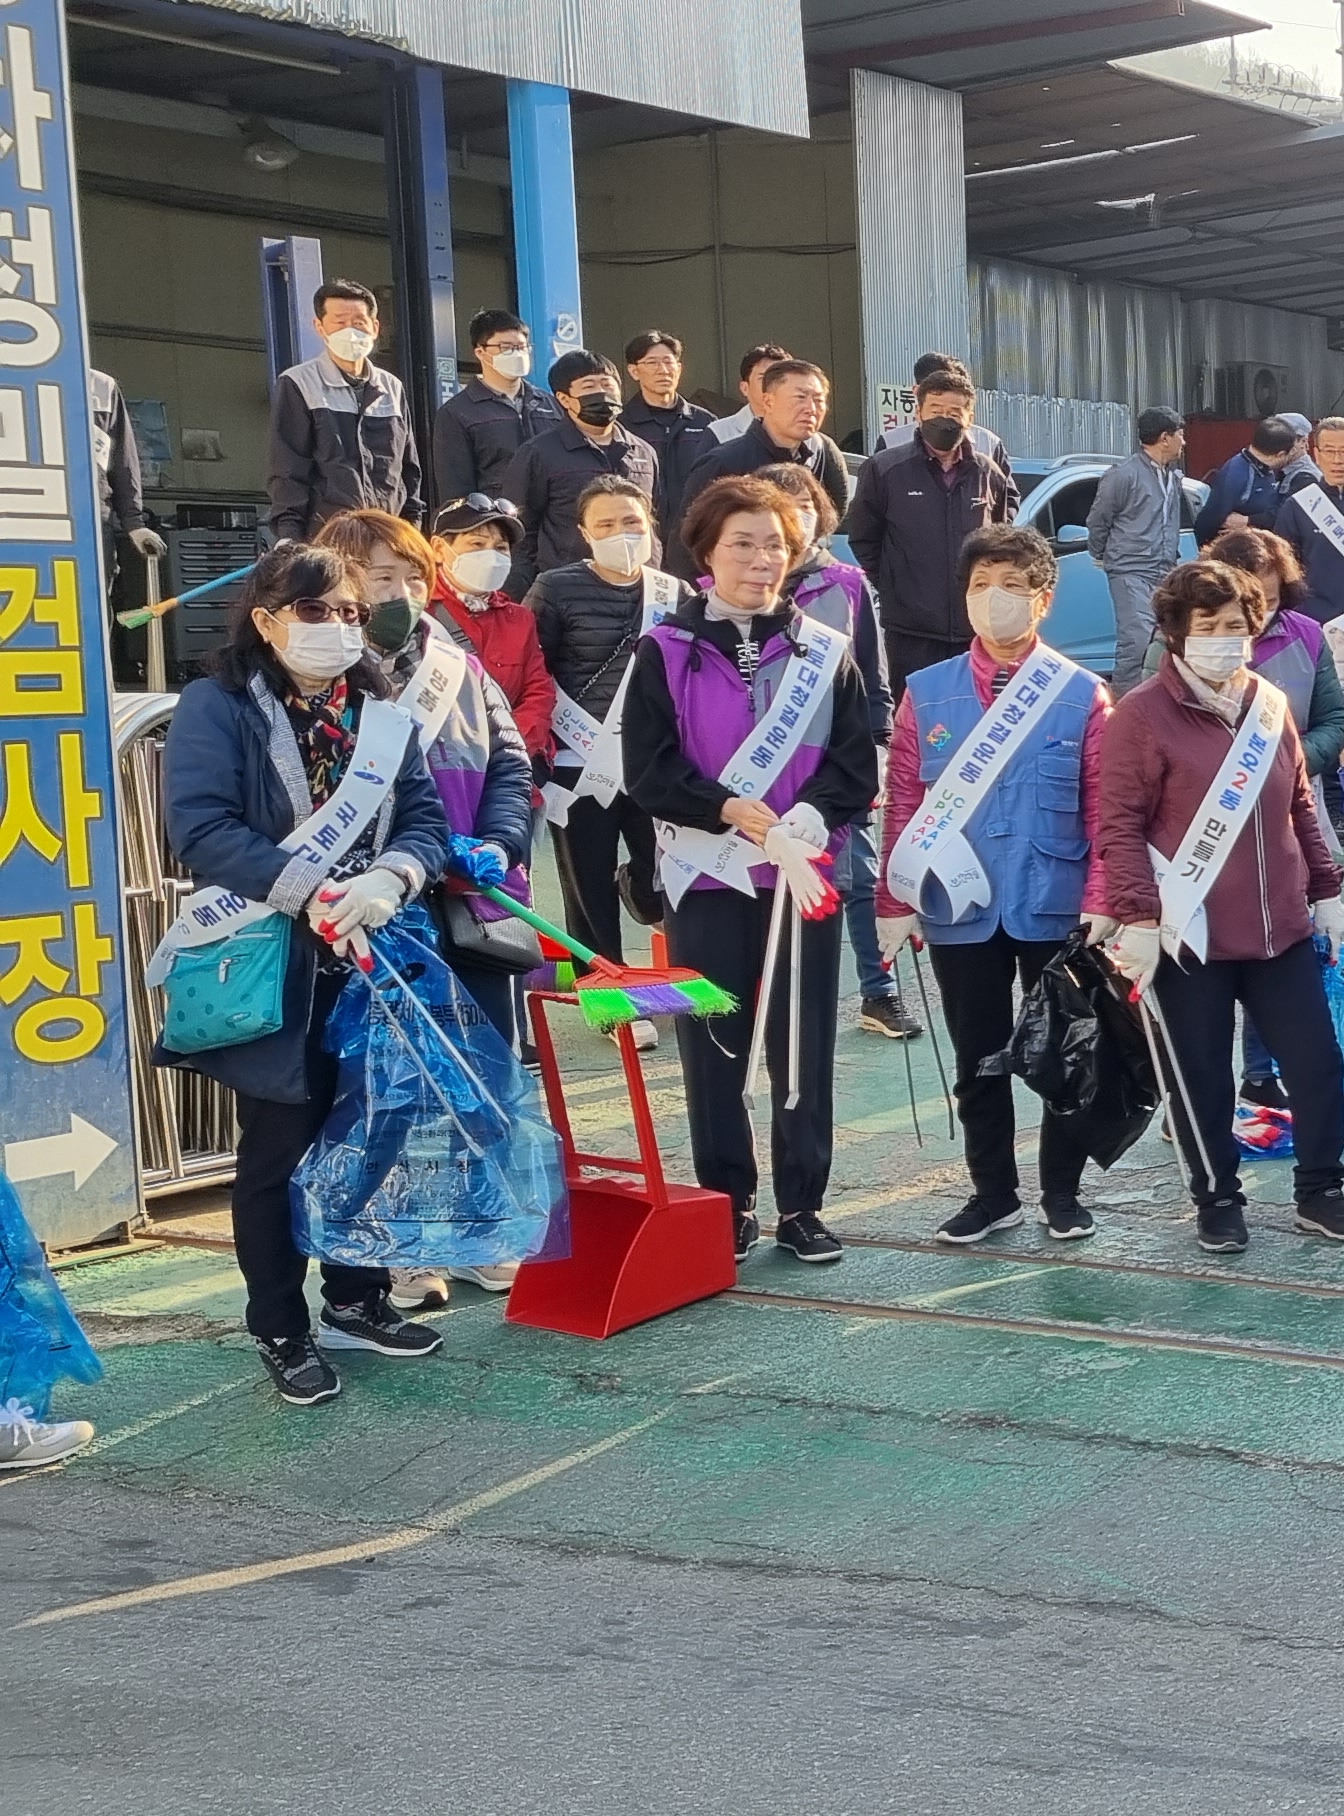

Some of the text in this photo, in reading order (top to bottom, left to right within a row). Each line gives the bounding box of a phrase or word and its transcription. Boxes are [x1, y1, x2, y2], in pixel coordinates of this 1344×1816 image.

[416, 667, 449, 713] 명품
[750, 629, 833, 770] 국토대청결운동
[958, 653, 1063, 785] 국토대청결운동
[934, 788, 955, 811] UP
[1218, 731, 1269, 812] 본오2동
[910, 814, 936, 845] DAY
[918, 796, 966, 851] CLEAN
[1180, 816, 1228, 884] 만들기
